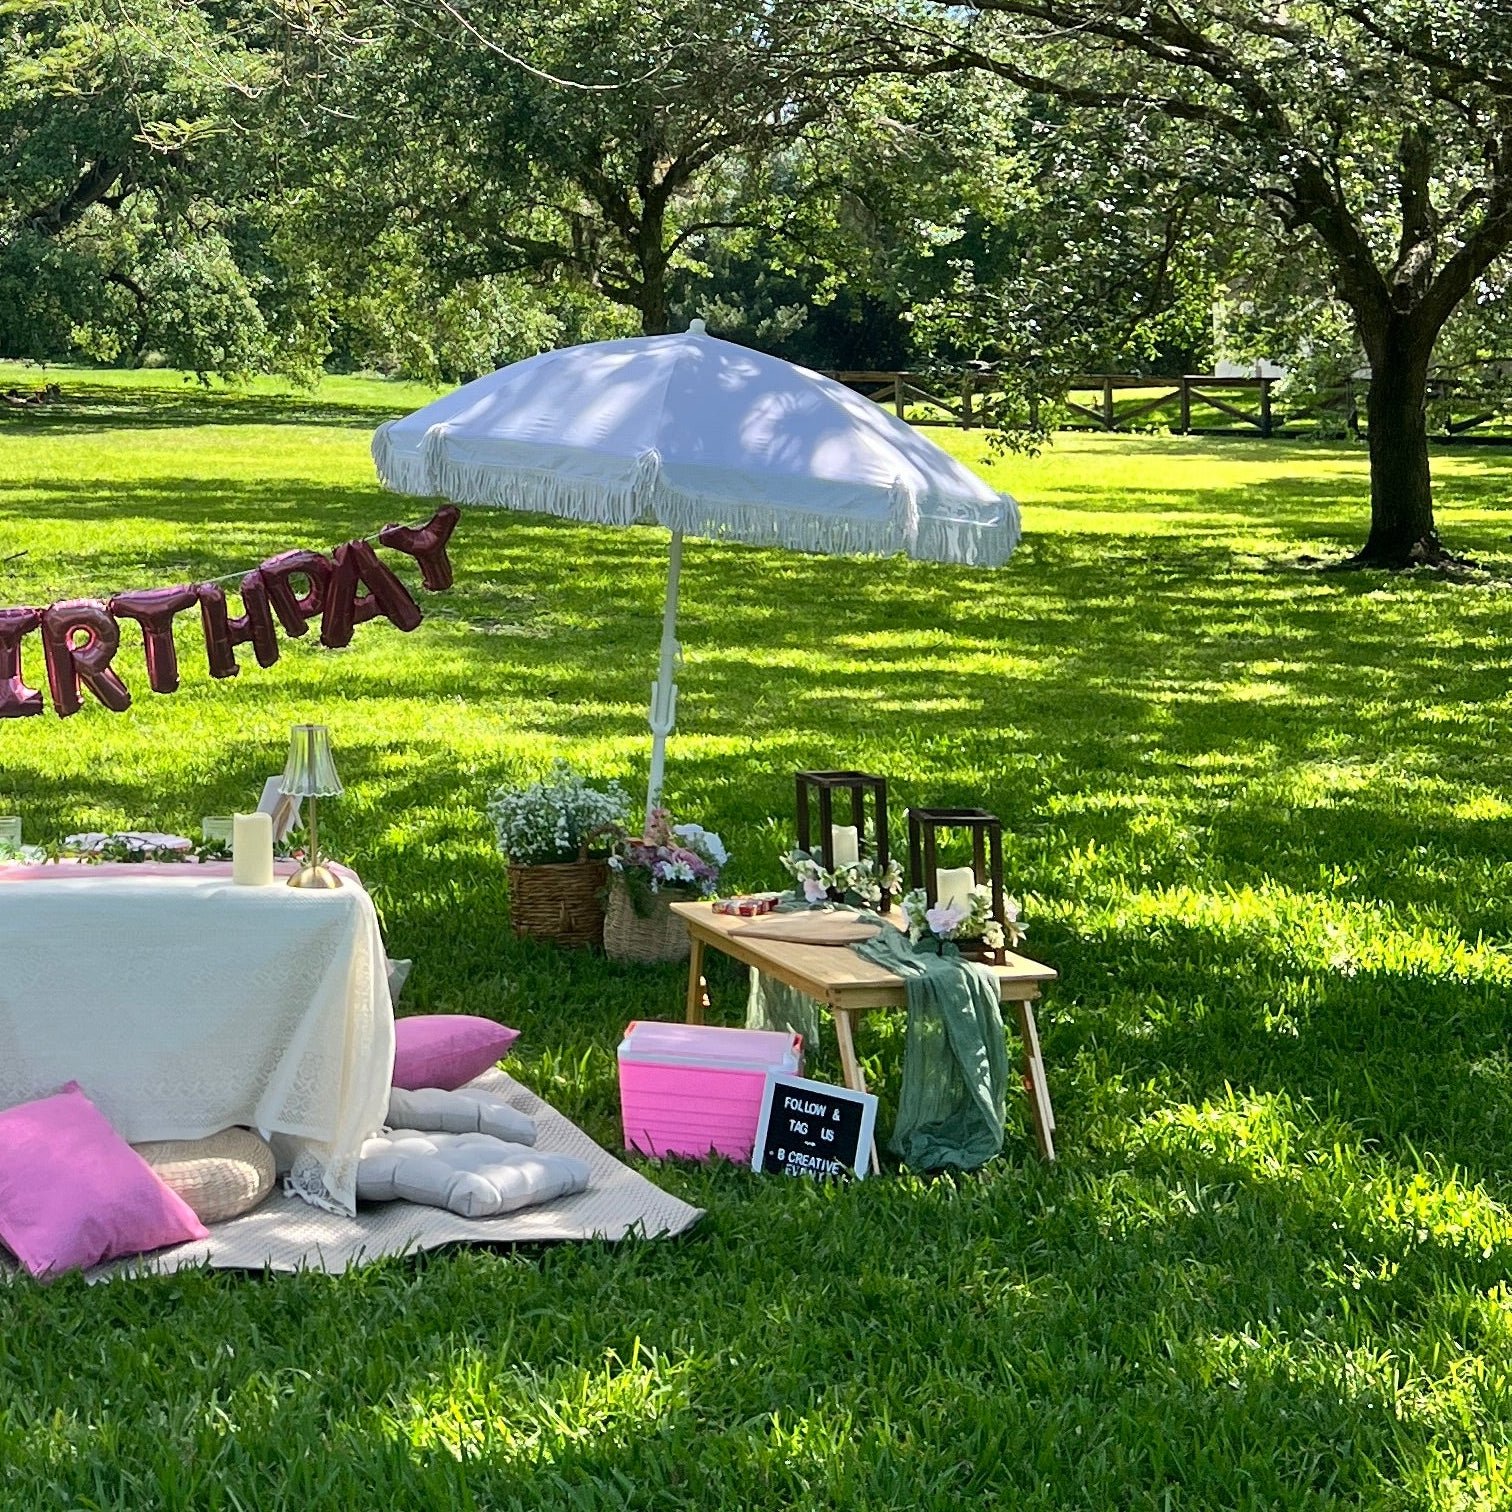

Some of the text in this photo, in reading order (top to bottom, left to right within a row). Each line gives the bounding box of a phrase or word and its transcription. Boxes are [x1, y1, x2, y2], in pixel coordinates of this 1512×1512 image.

[784, 1096, 841, 1122] FOLLOW &
[789, 1119, 835, 1142] TAG US
[777, 1148, 840, 1175] B CREATIVE
